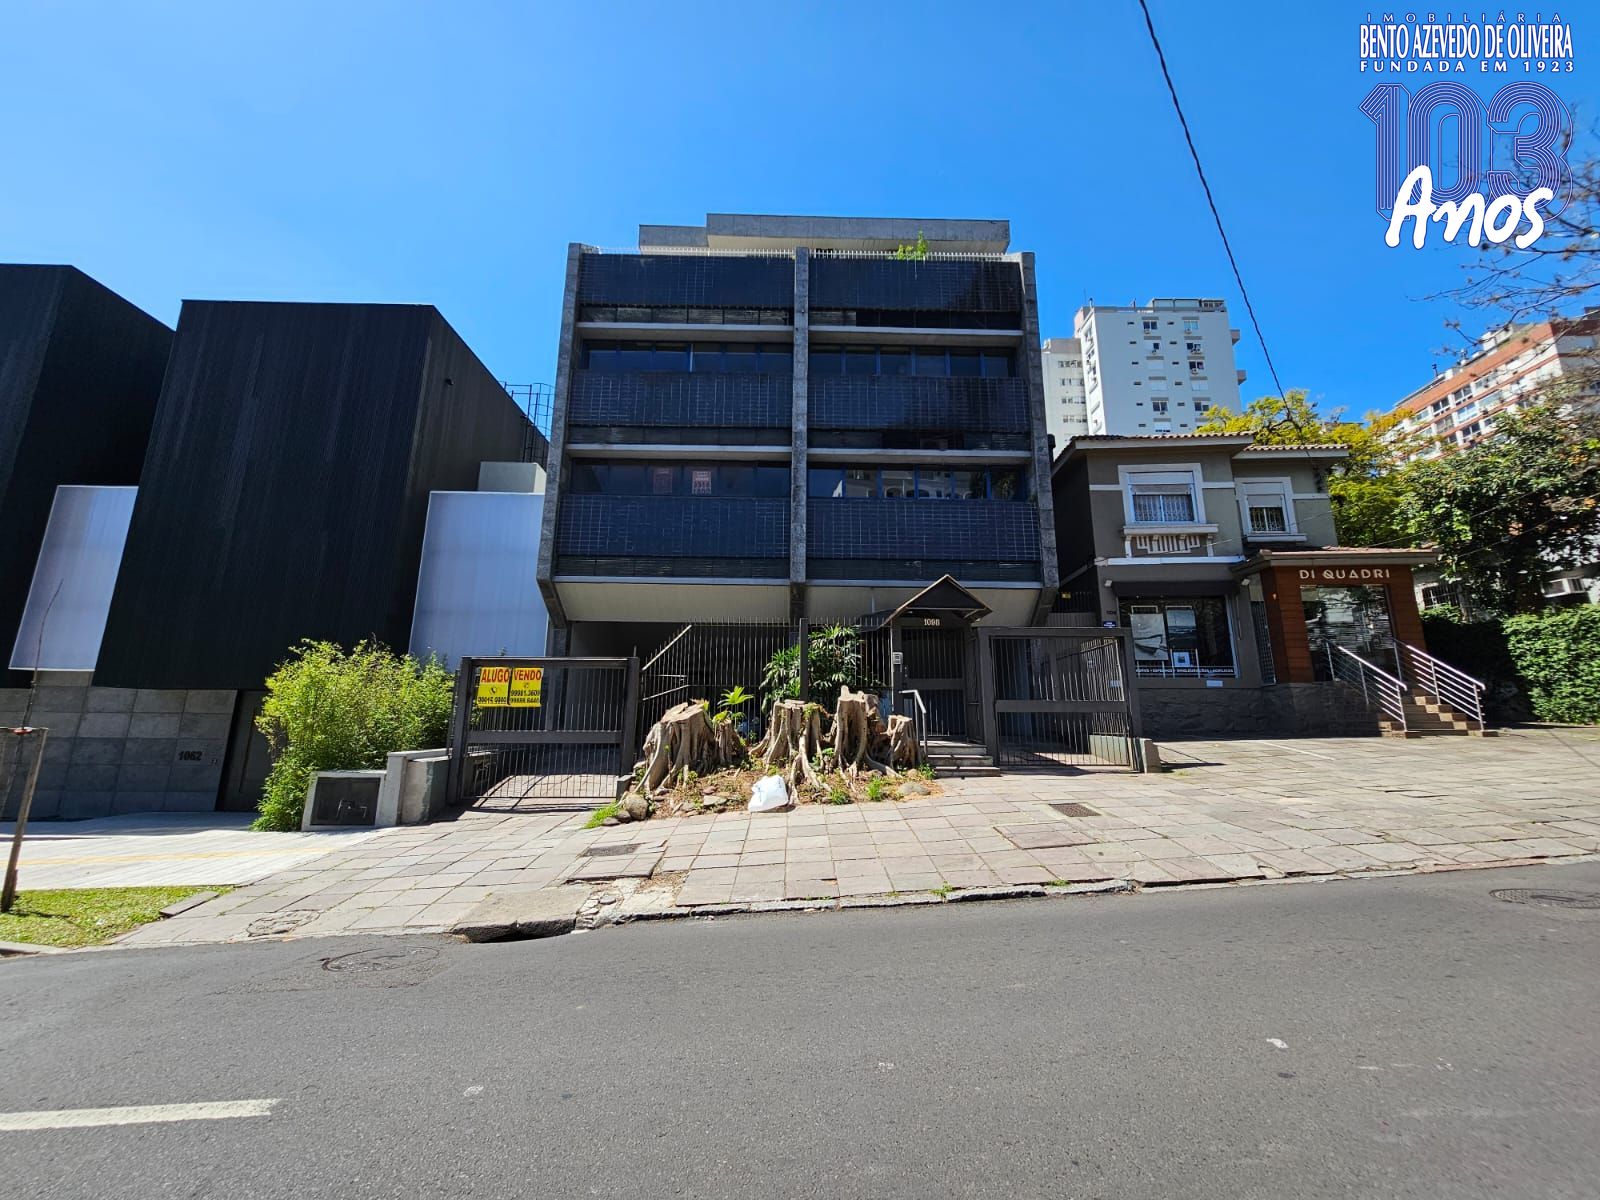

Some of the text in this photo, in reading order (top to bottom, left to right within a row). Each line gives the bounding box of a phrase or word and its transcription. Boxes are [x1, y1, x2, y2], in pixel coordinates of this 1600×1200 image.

[1299, 568, 1390, 579] DI QUADRI
[481, 669, 510, 682] ALUGO
[514, 670, 542, 681] VENDO
